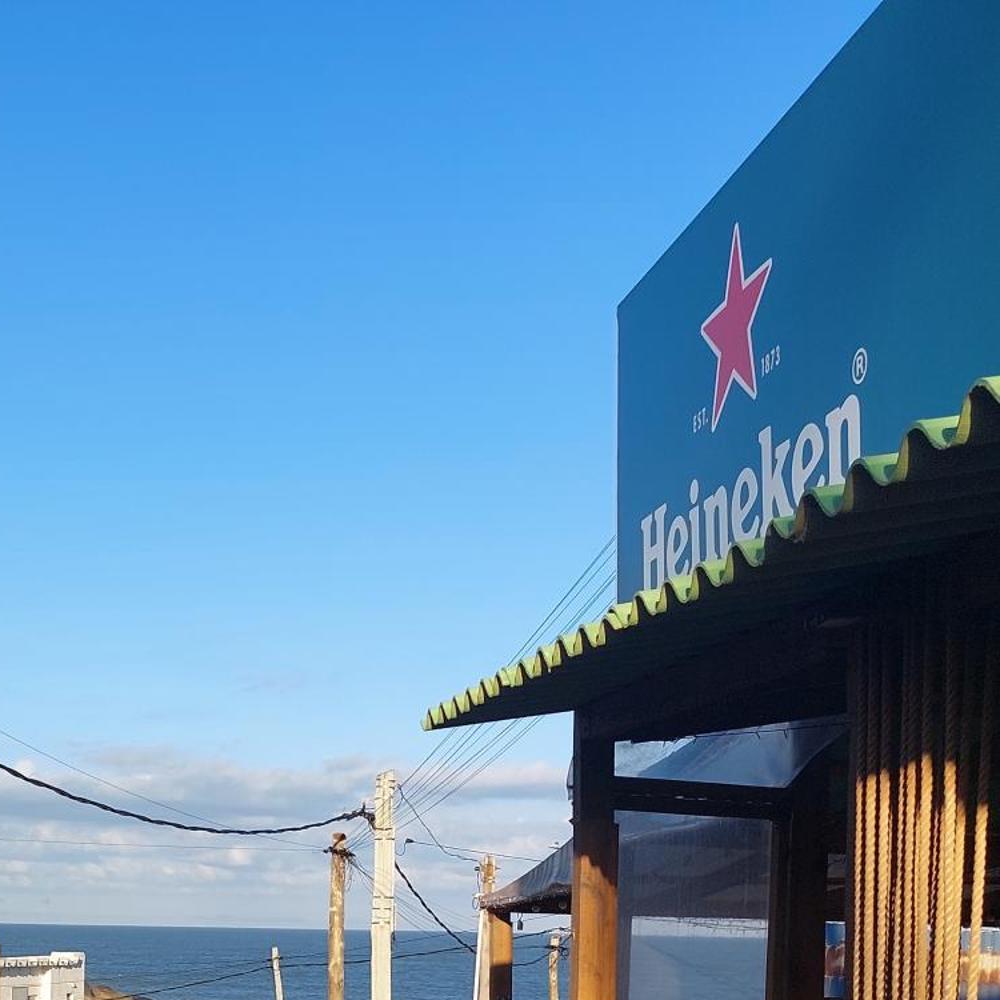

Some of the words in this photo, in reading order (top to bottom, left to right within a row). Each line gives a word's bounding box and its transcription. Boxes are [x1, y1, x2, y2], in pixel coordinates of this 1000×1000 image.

[760, 344, 781, 378] 1873
[692, 406, 709, 434] EST.
[640, 393, 862, 592] Heineken
